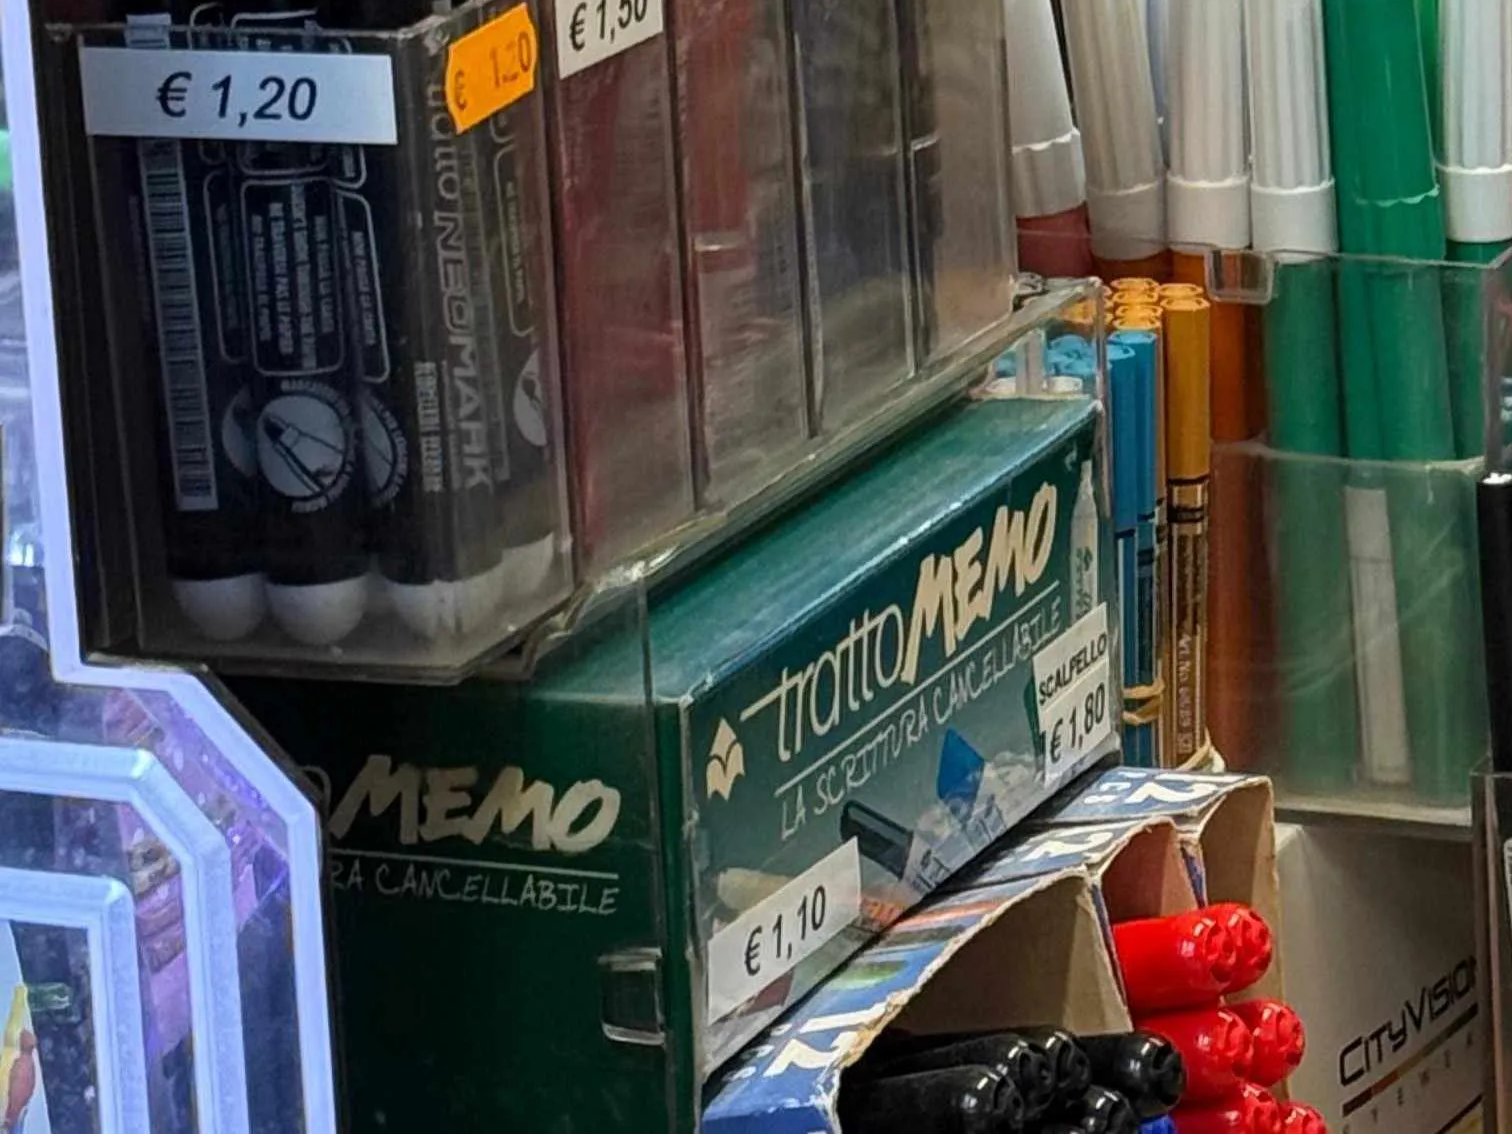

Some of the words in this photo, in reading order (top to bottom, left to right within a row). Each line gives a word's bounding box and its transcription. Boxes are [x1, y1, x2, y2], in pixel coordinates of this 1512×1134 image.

[569, 2, 587, 52] €
[157, 71, 193, 119] €
[211, 74, 318, 128] 1,20
[1038, 633, 1108, 707] SCALPELLO
[780, 785, 806, 842] LA
[814, 700, 928, 815] SCRITTURA
[932, 597, 1061, 726] CANCELLABILE
[1050, 721, 1064, 763] €
[1069, 683, 1106, 750] 1,80
[375, 862, 621, 916] CANCELLABILE
[743, 920, 763, 977] €
[771, 885, 827, 962] 1,10
